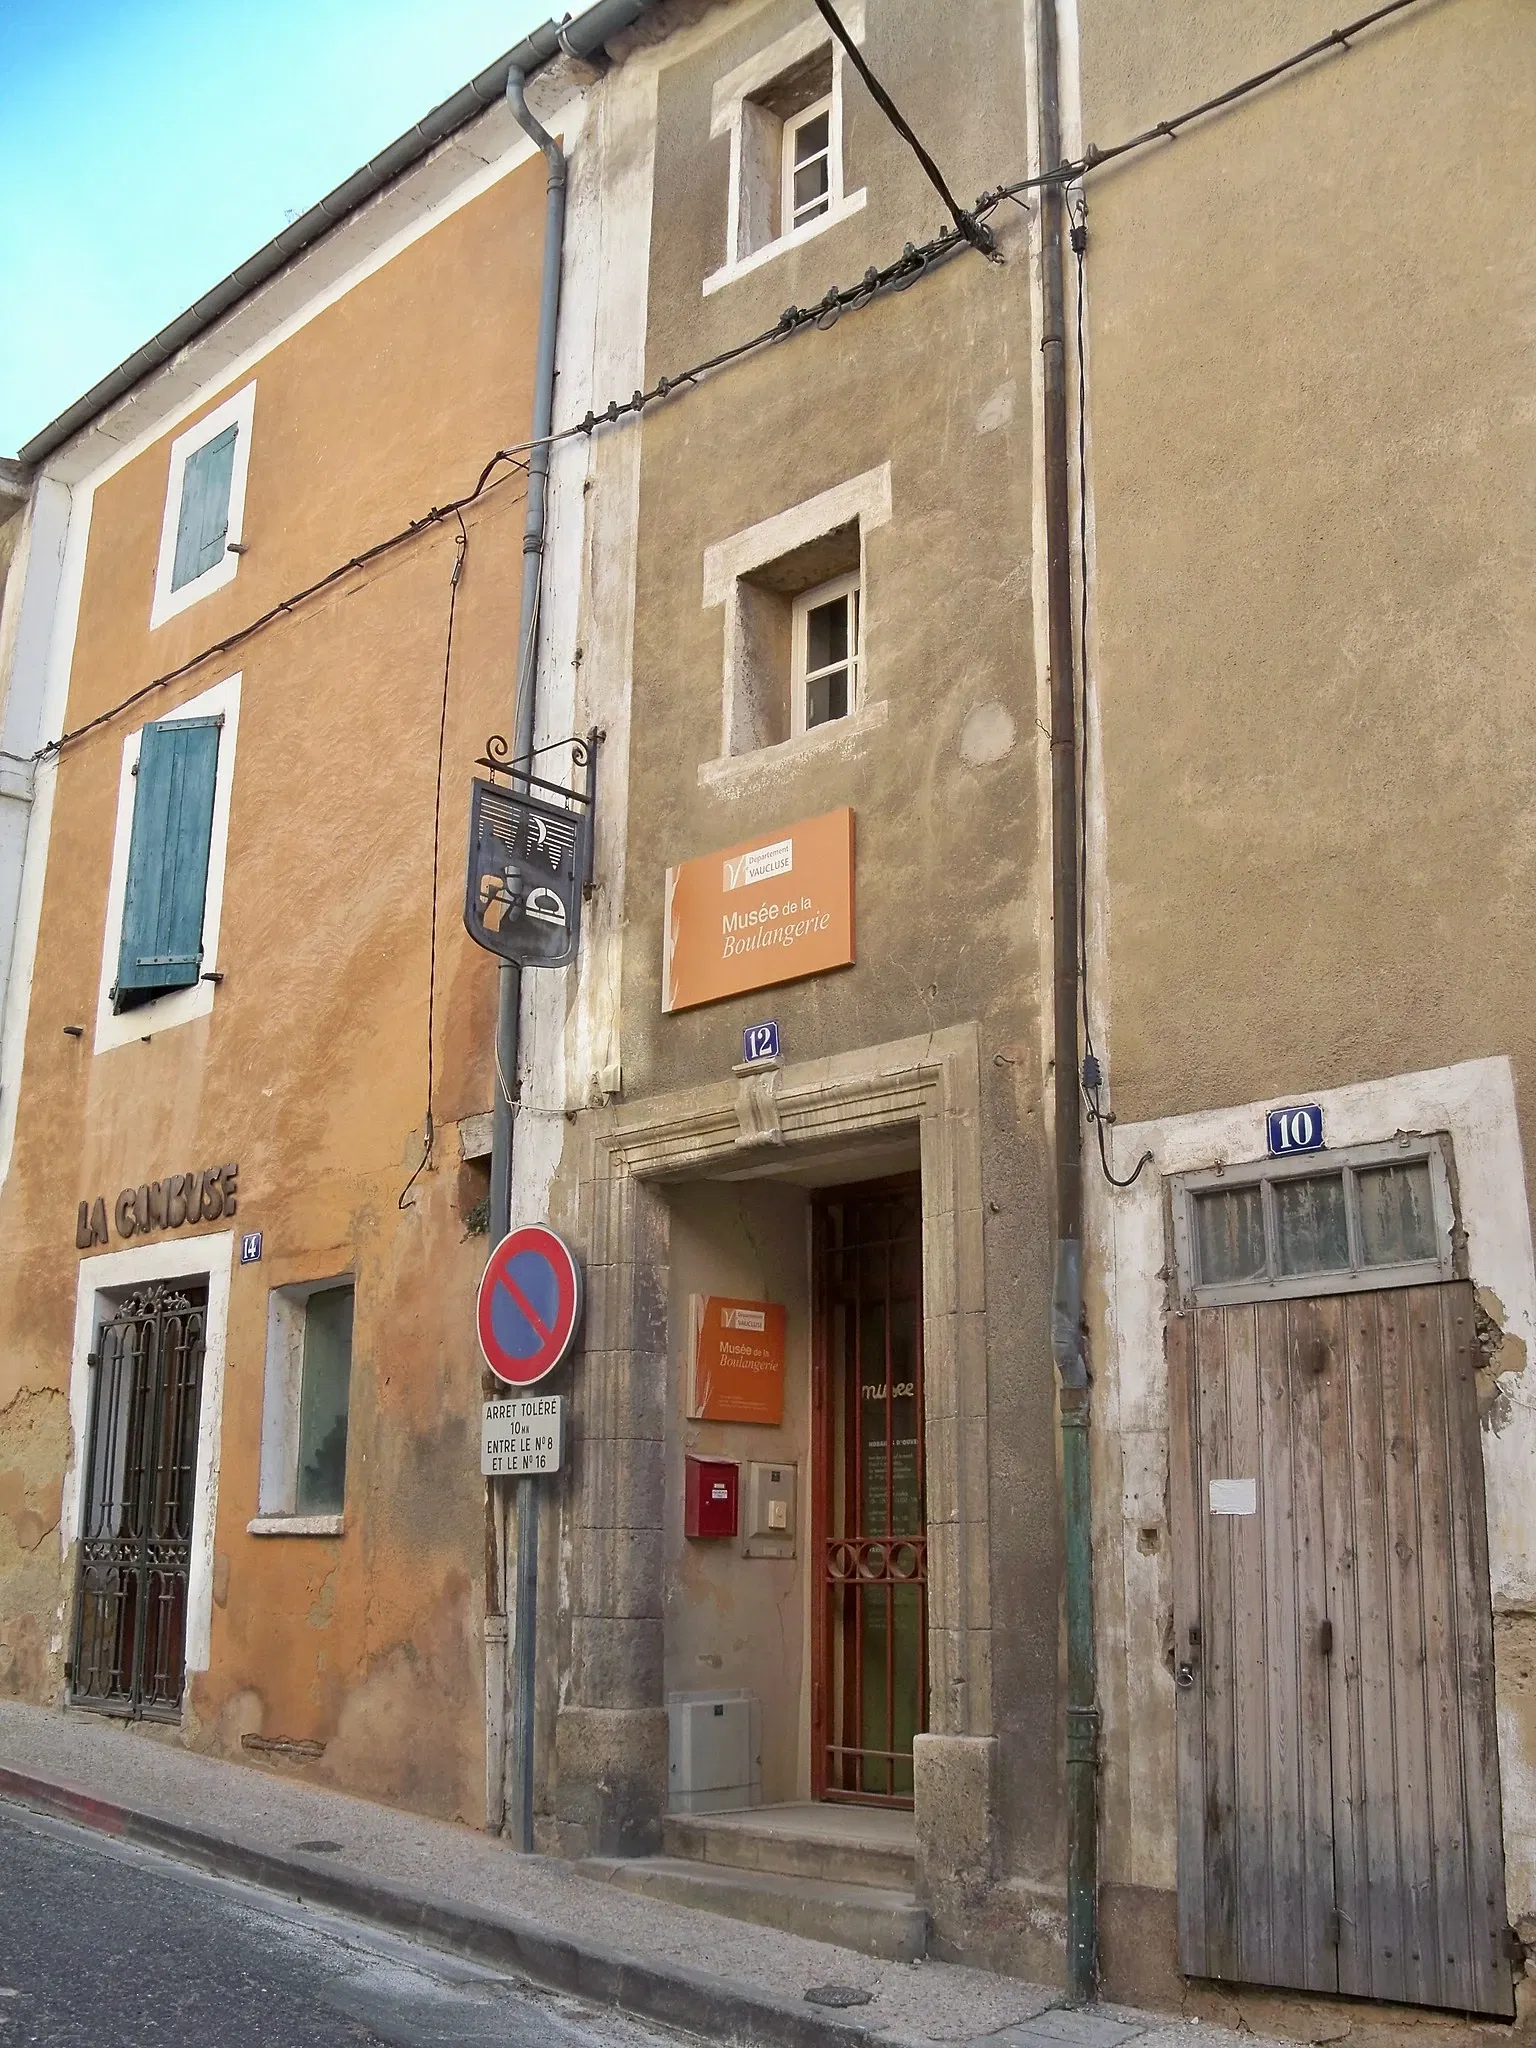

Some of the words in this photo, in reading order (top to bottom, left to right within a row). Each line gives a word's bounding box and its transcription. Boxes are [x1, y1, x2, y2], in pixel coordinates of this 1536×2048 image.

[748, 846, 789, 864] Département
[749, 858, 790, 878] VAUCLUSE
[722, 903, 780, 935] Musée
[782, 901, 798, 916] de
[800, 896, 813, 911] la
[722, 910, 831, 959] Boulangerie
[750, 1027, 772, 1058] 12
[1278, 1111, 1313, 1149] 10
[76, 1196, 108, 1249] LA
[114, 1162, 239, 1239] CAMBUSE
[243, 1236, 257, 1259] 14
[719, 1341, 752, 1355] Musée
[719, 1354, 779, 1373] Boulangerie
[486, 1404, 516, 1419] ARRET
[521, 1398, 556, 1416] TOLÉRÉ
[487, 1438, 515, 1453] ENTRE
[520, 1437, 530, 1451] LE
[547, 1436, 552, 1449] 8
[492, 1457, 502, 1470] ET
[507, 1456, 517, 1469] LE
[535, 1454, 545, 1467] 16
